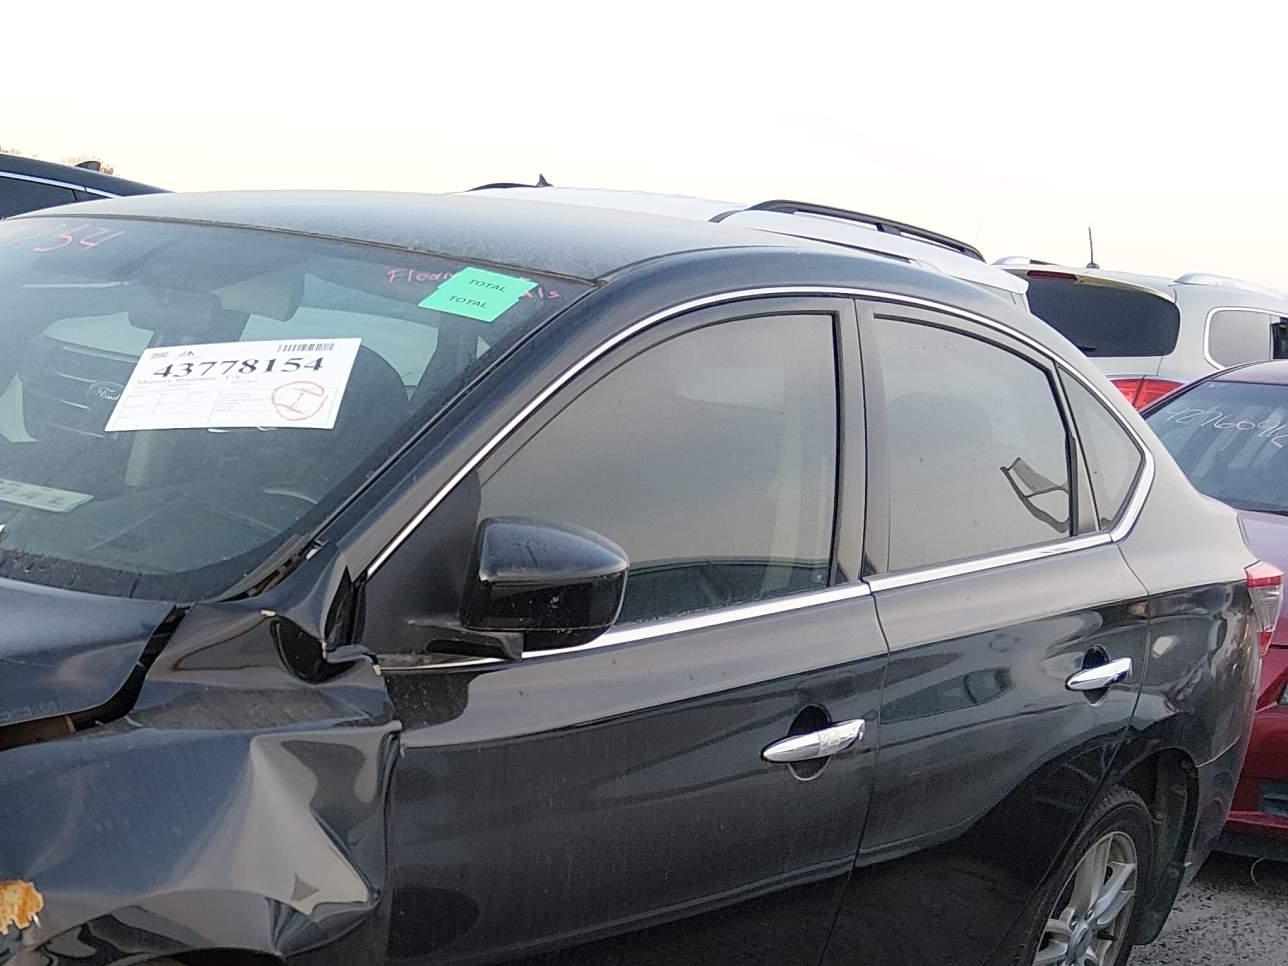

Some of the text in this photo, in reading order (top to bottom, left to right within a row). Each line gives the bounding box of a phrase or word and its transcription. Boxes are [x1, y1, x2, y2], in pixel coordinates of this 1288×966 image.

[469, 279, 505, 293] TOTAL
[448, 295, 488, 309] TOTAL
[152, 356, 325, 379] 43778154
